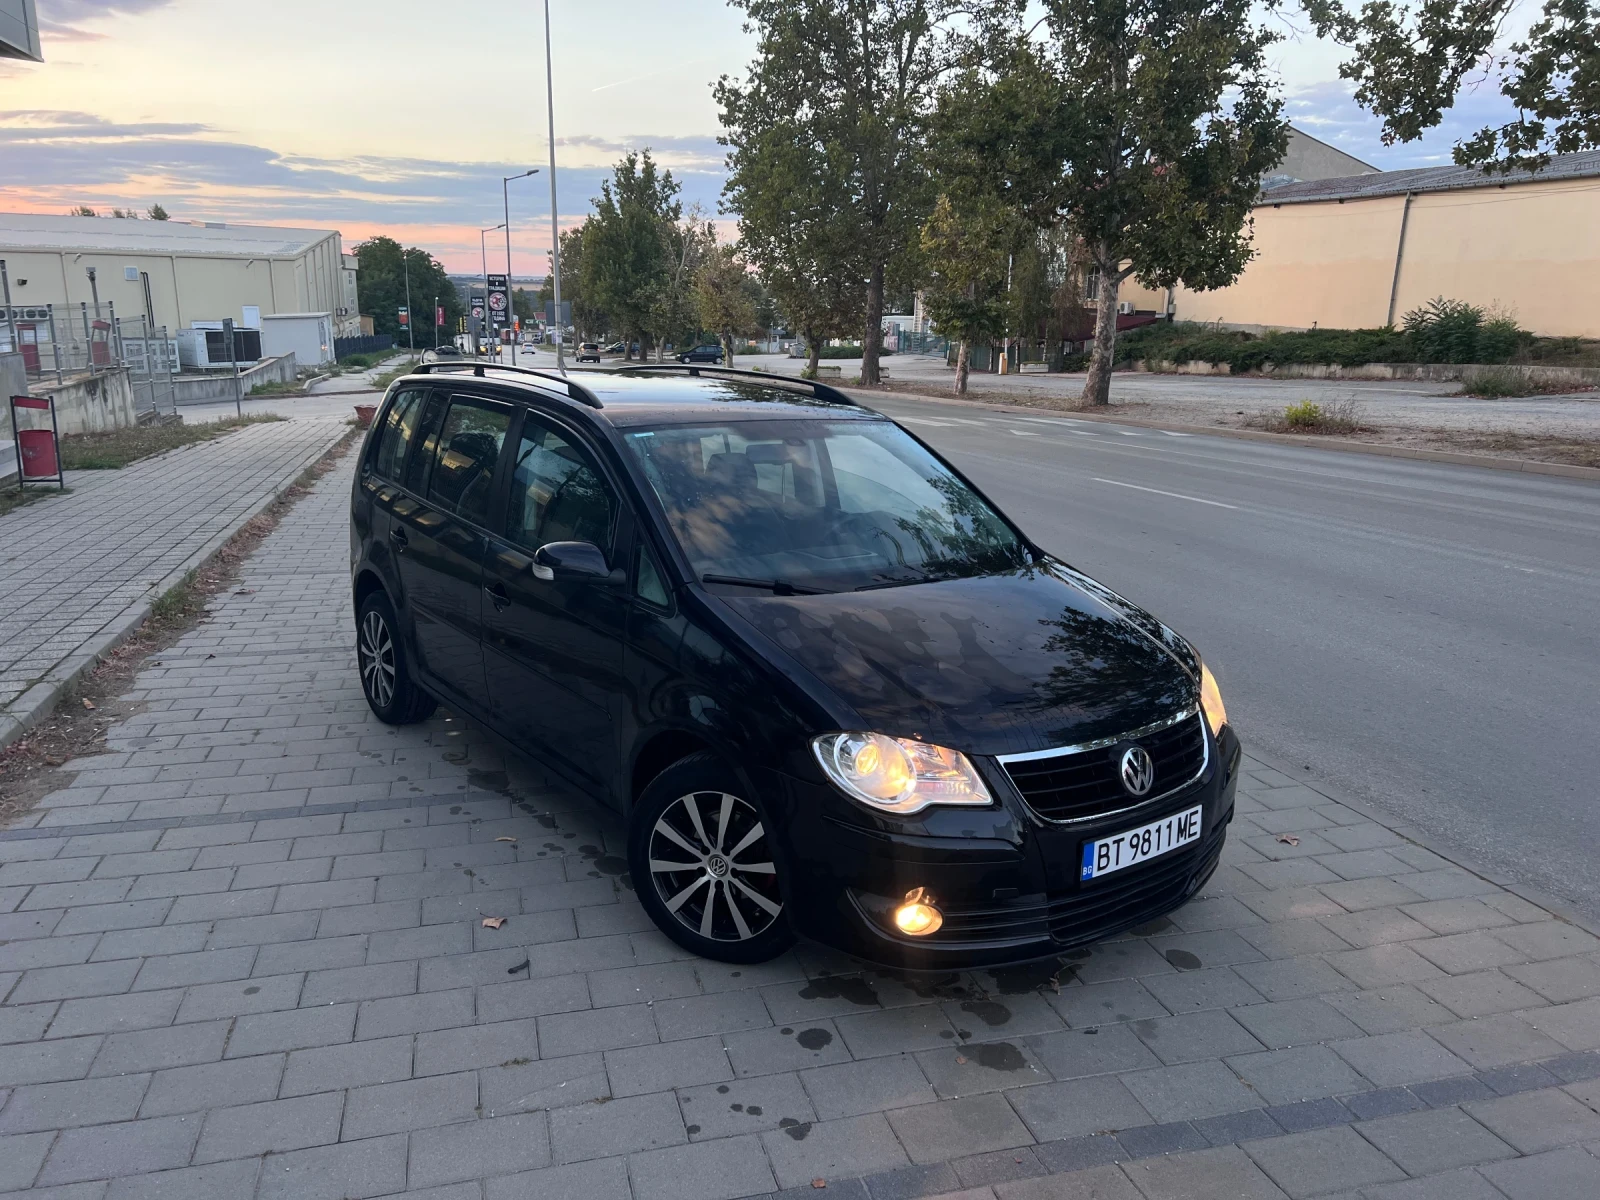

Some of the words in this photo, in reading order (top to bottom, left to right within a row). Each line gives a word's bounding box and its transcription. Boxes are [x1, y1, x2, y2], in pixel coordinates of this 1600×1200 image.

[1097, 837, 1125, 872] BT
[1129, 820, 1173, 861] 9811
[1177, 810, 1198, 843] ME
[1082, 865, 1093, 876] BG
